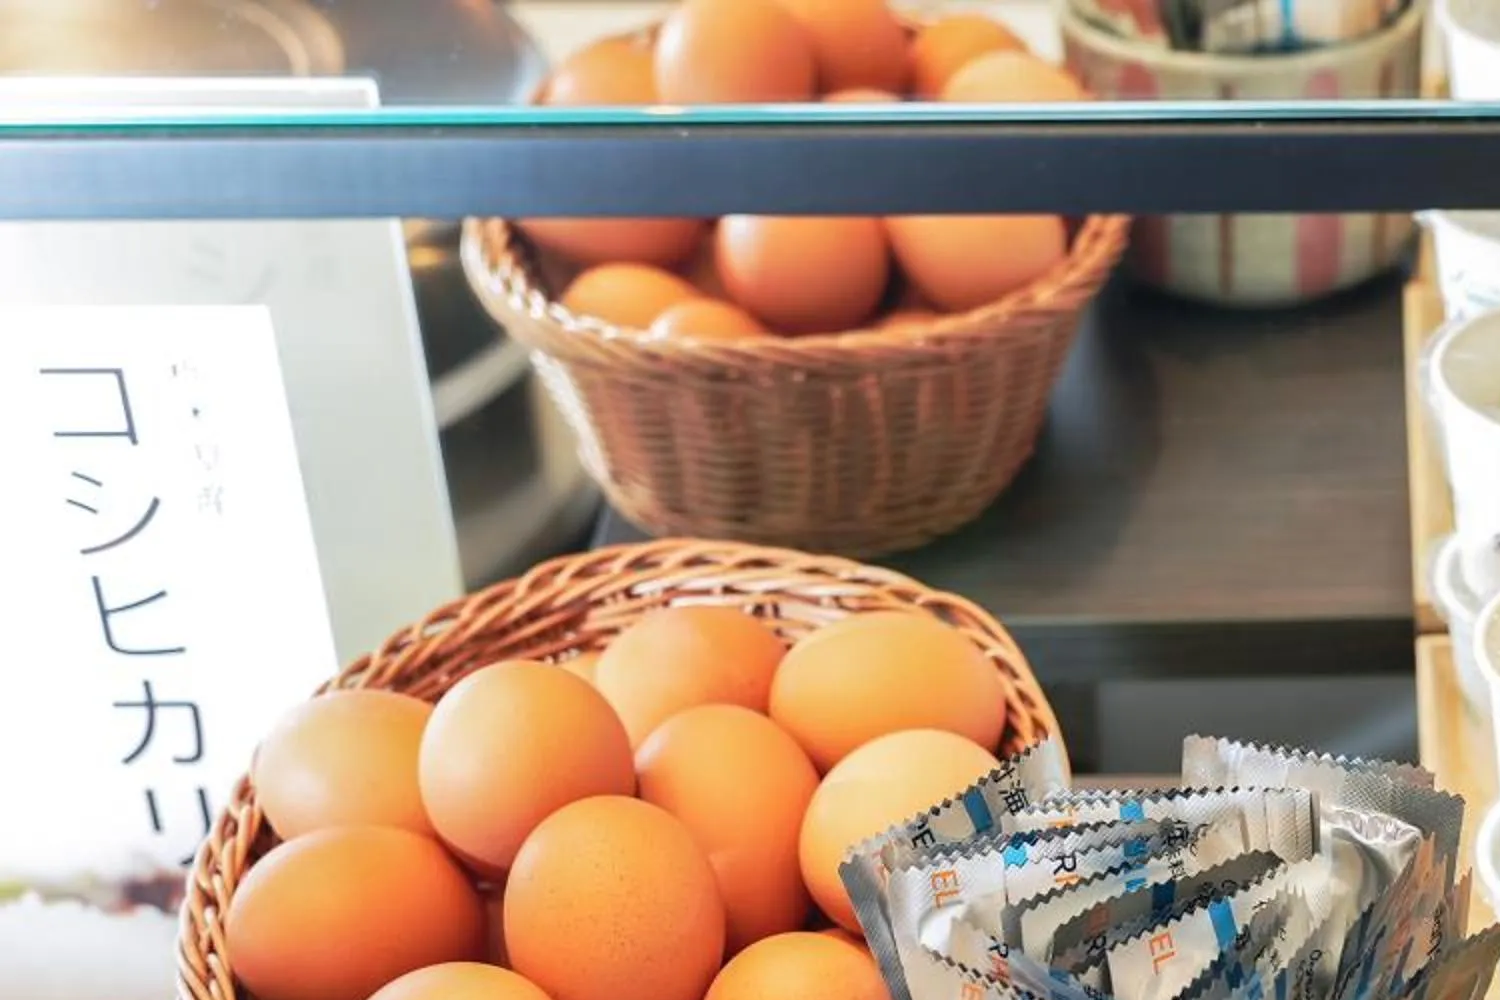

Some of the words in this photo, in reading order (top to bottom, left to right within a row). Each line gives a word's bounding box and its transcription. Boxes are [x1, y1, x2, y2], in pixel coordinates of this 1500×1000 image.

[40, 368, 210, 866] コシヒカリ
